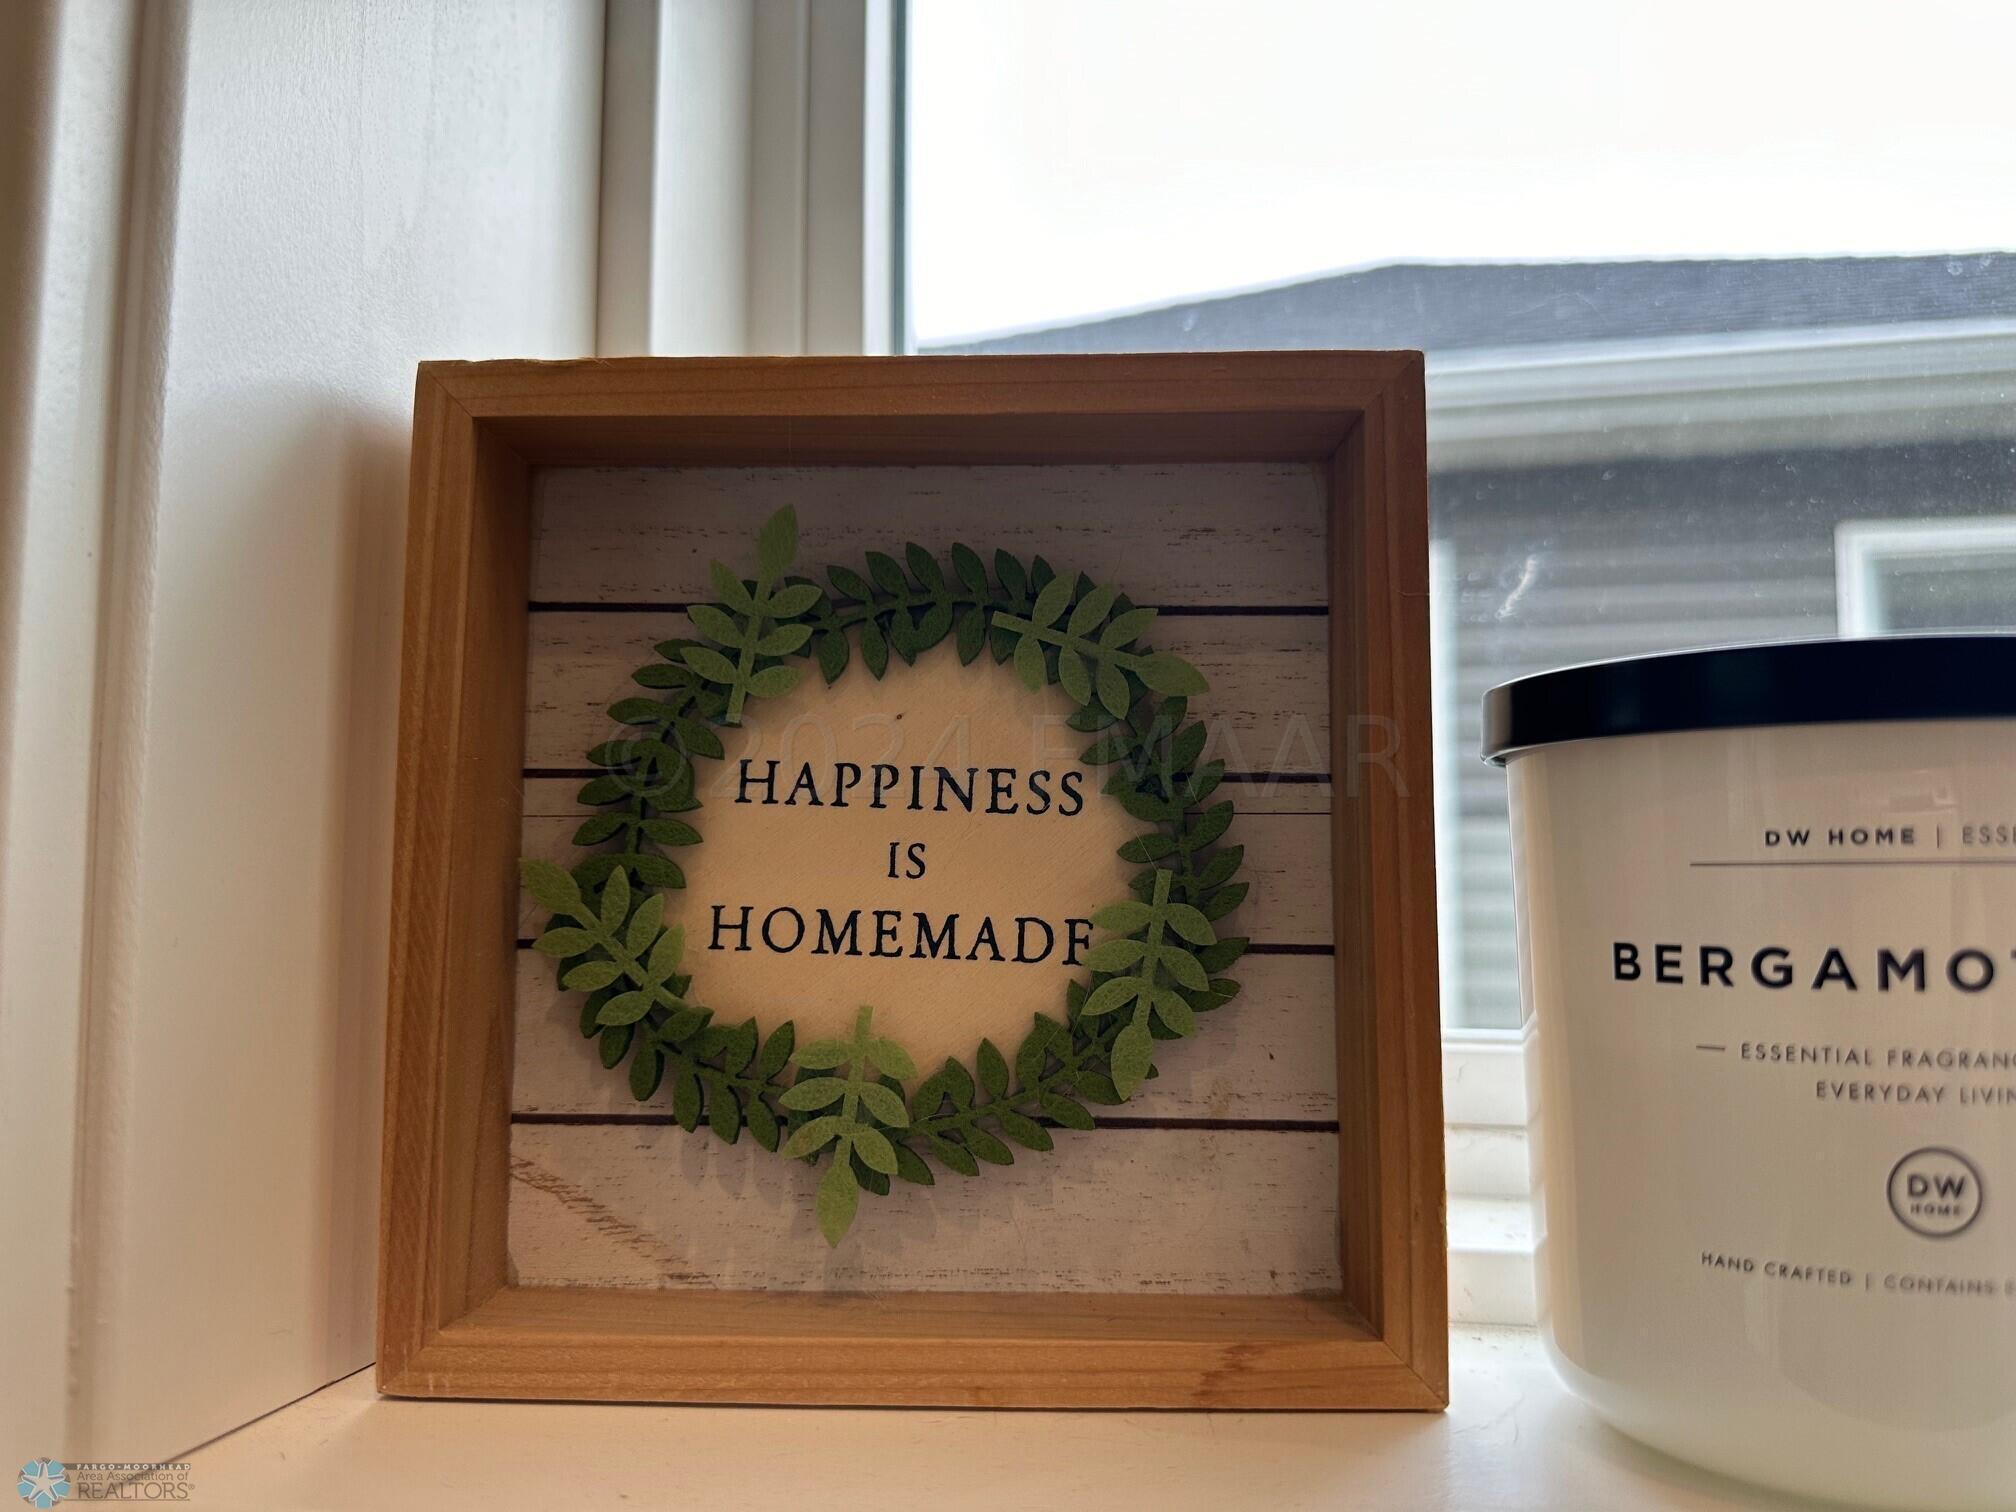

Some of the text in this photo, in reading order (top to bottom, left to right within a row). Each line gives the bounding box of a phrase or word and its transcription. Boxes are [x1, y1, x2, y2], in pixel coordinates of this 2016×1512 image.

[734, 758, 1085, 817] HAPPINESS
[1764, 825, 2016, 846] DW HOME ESS
[887, 842, 926, 879] IS
[1612, 941, 2016, 993] BERGAMO
[1740, 1042, 2016, 1070] ESSENTIAL FRAGRAN
[1816, 1080, 1946, 1105] EVERYDAY
[1906, 1173, 1966, 1199] DW
[1910, 1203, 1963, 1217] HOME
[1701, 1251, 1755, 1274] HAND
[1764, 1260, 1852, 1286] CRAFTED
